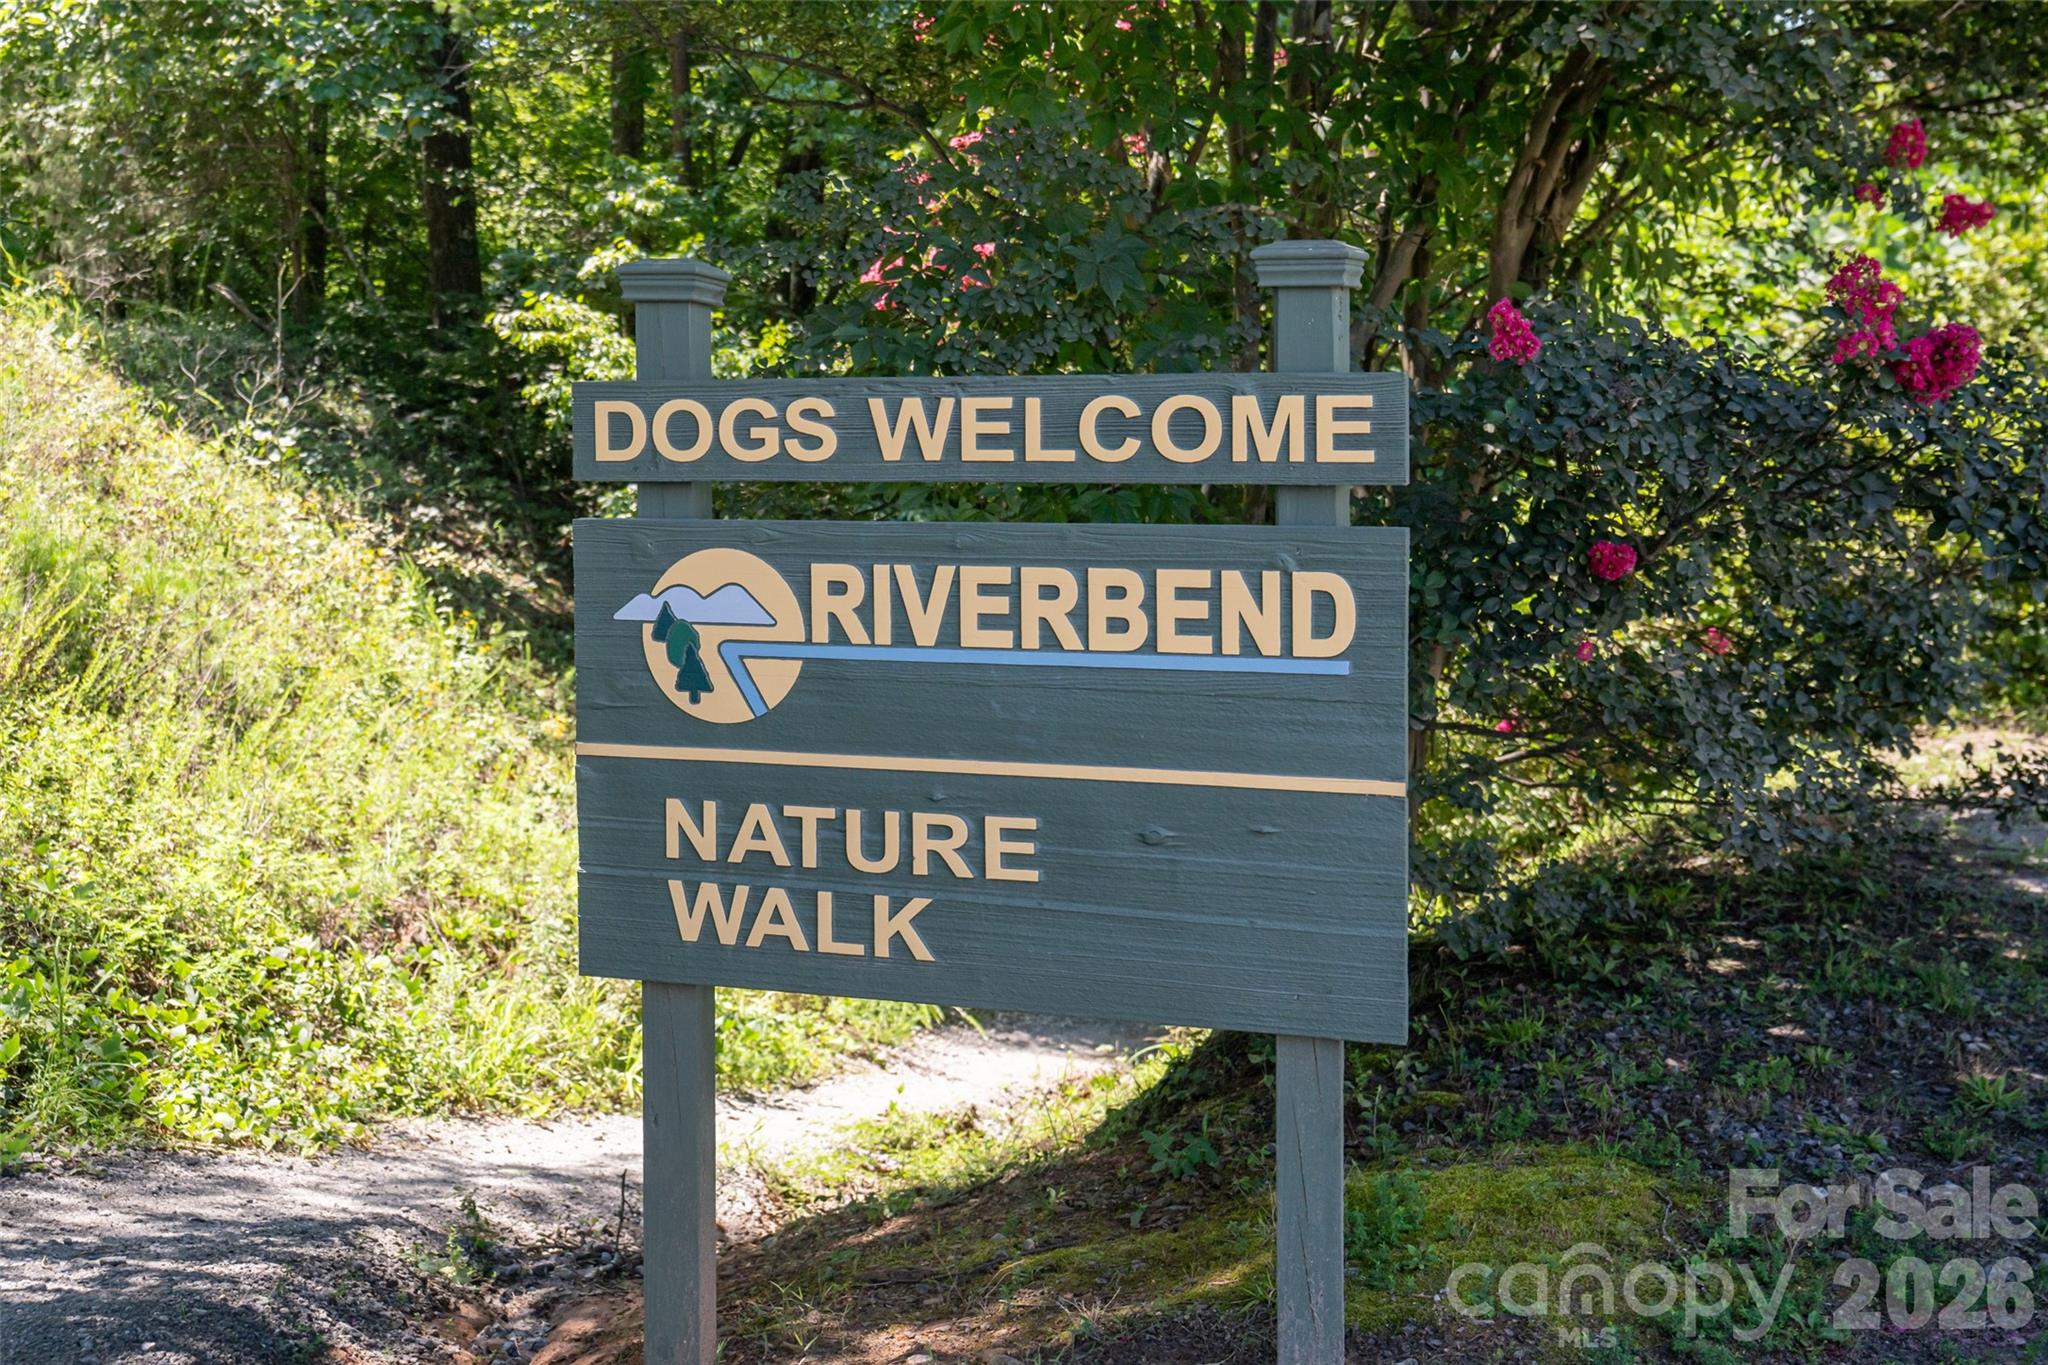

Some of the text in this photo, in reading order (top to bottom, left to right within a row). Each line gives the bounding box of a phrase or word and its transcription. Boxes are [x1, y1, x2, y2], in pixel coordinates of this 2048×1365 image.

[594, 395, 1376, 463] DOGS WELCOME
[810, 563, 1357, 658] RIVERBEND
[665, 798, 1040, 883] NATURE
[668, 879, 935, 962] WALK
